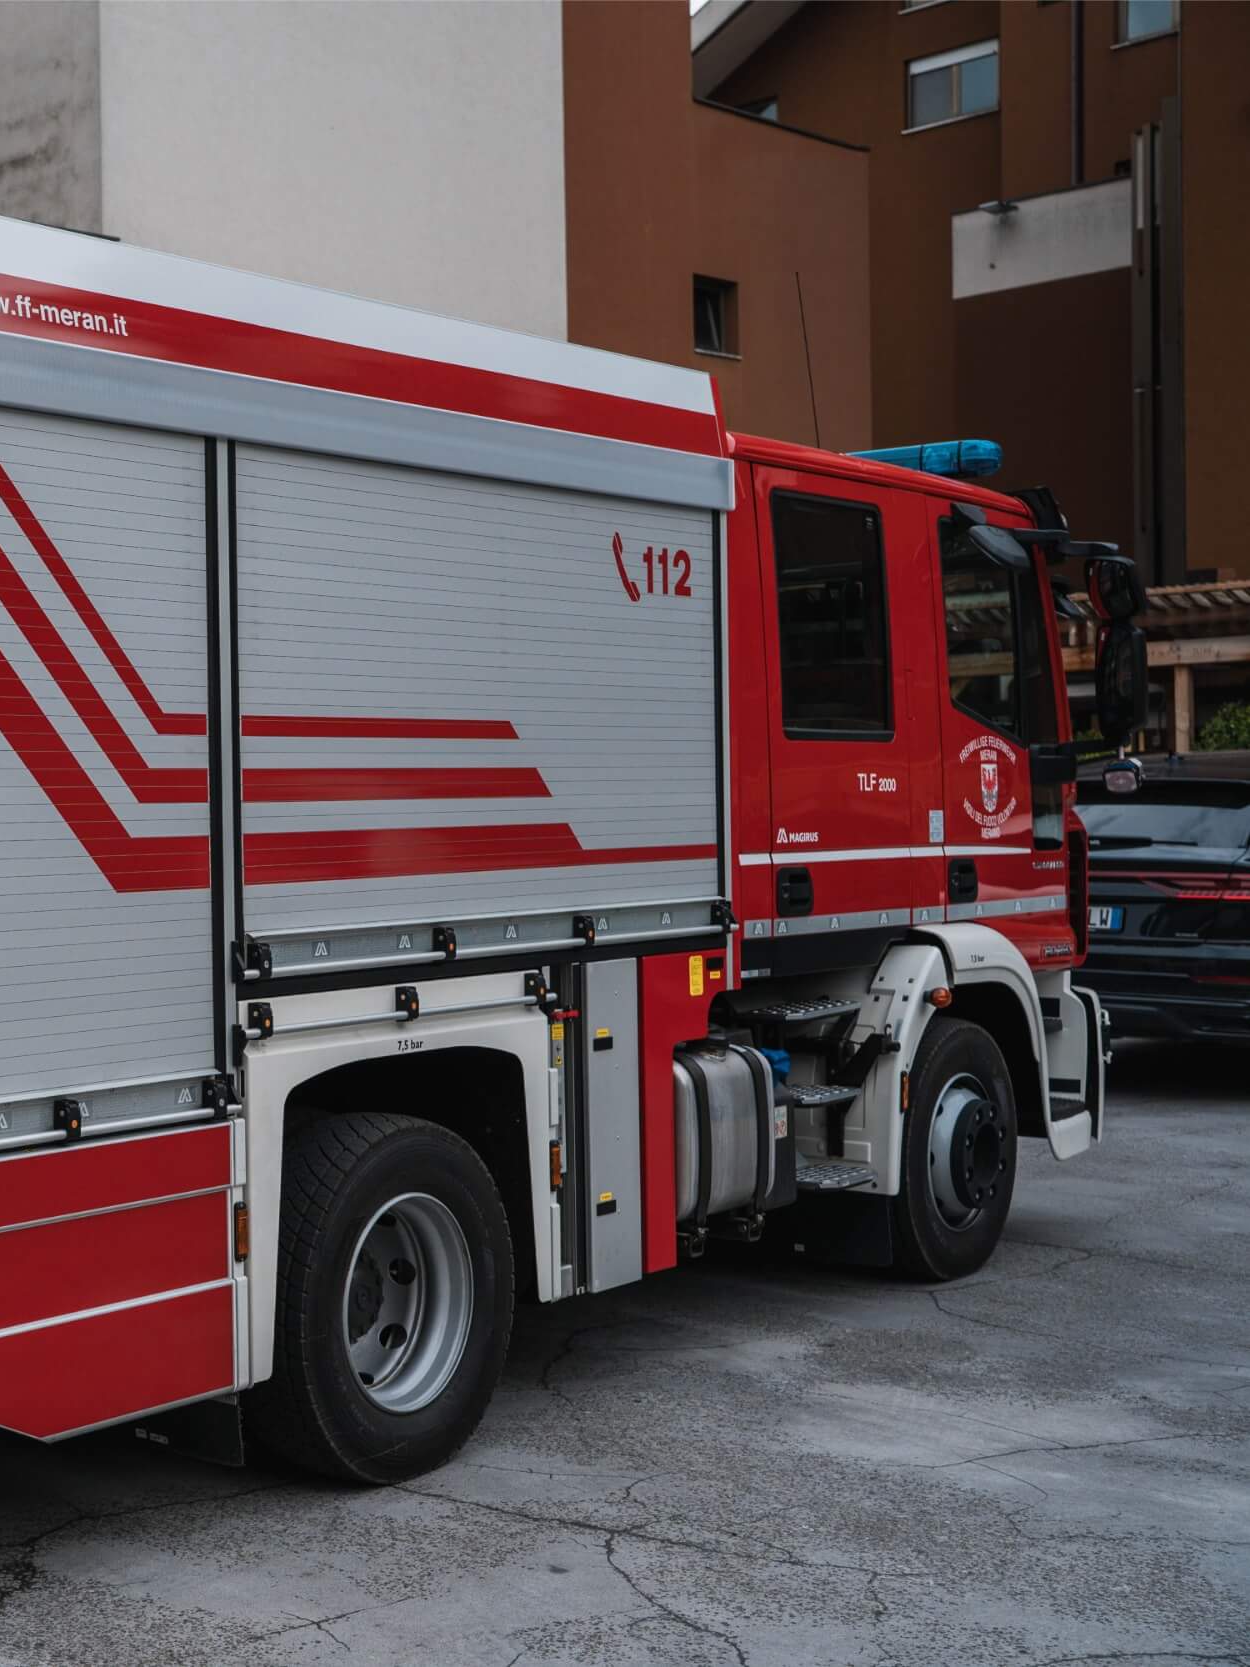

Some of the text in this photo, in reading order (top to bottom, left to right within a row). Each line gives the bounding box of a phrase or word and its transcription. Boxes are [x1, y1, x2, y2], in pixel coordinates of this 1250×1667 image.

[642, 546, 692, 596] 112
[857, 773, 897, 792] TLF 2000
[789, 832, 819, 843] MAGIRUS
[397, 1039, 424, 1052] 7,5 bar
